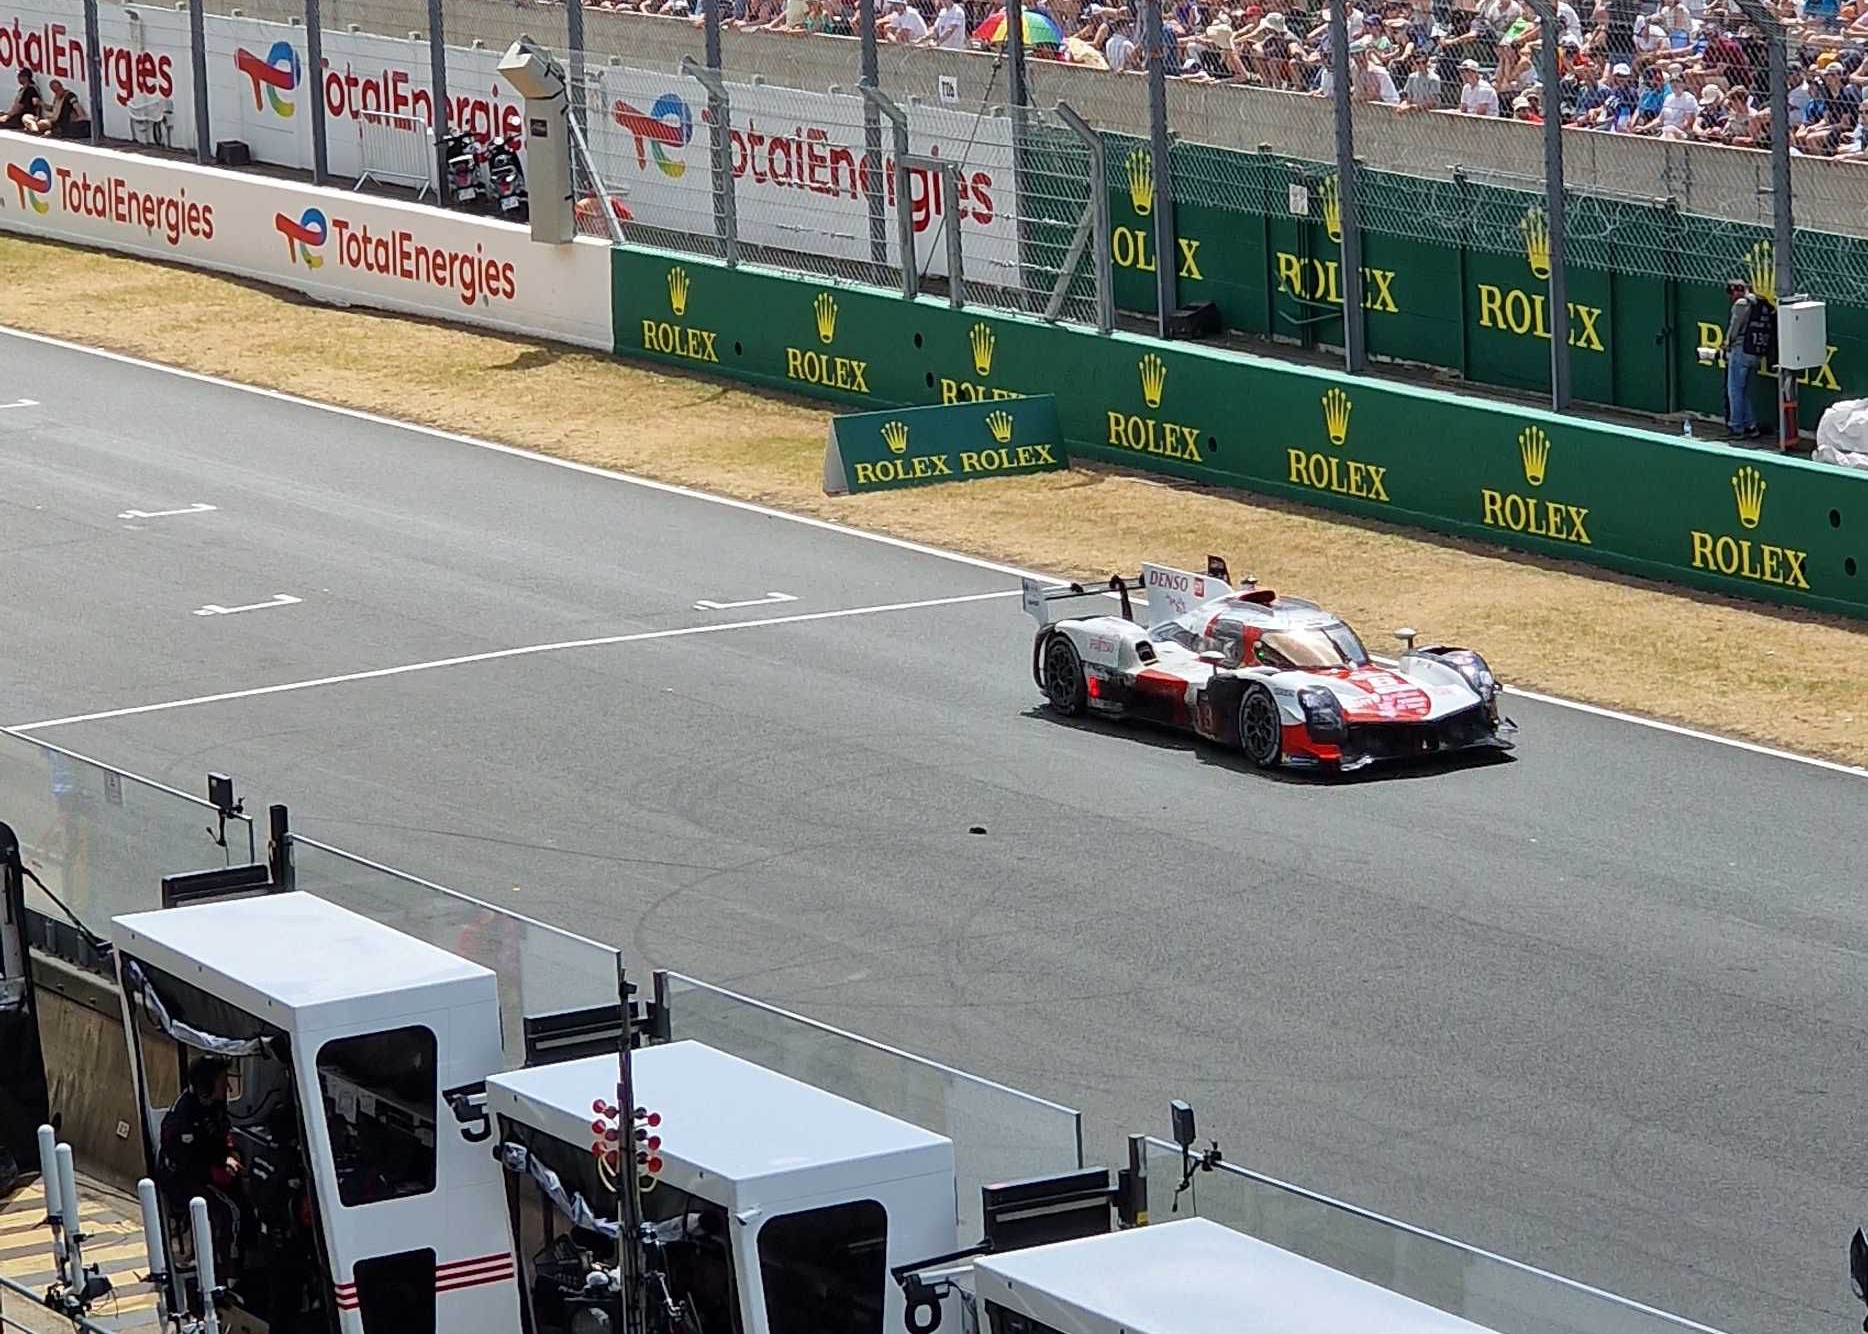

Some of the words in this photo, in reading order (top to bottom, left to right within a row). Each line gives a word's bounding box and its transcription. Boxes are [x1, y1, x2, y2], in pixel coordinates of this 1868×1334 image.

[55, 167, 214, 245] TotalEnergies
[332, 218, 516, 306] TotalEnergies
[1111, 226, 1204, 280] OLX
[642, 320, 719, 363] ROLEX
[1478, 284, 1605, 352] ROLX
[786, 347, 870, 393] ROLEX
[855, 454, 952, 484] ROLEX
[961, 444, 1058, 472] ROLEX
[1107, 411, 1202, 463] ROLEX
[1287, 447, 1390, 503] ROLEX
[1481, 488, 1592, 545] ROLEX
[1150, 570, 1188, 592] DENSO
[1690, 530, 1810, 590] ROLEX
